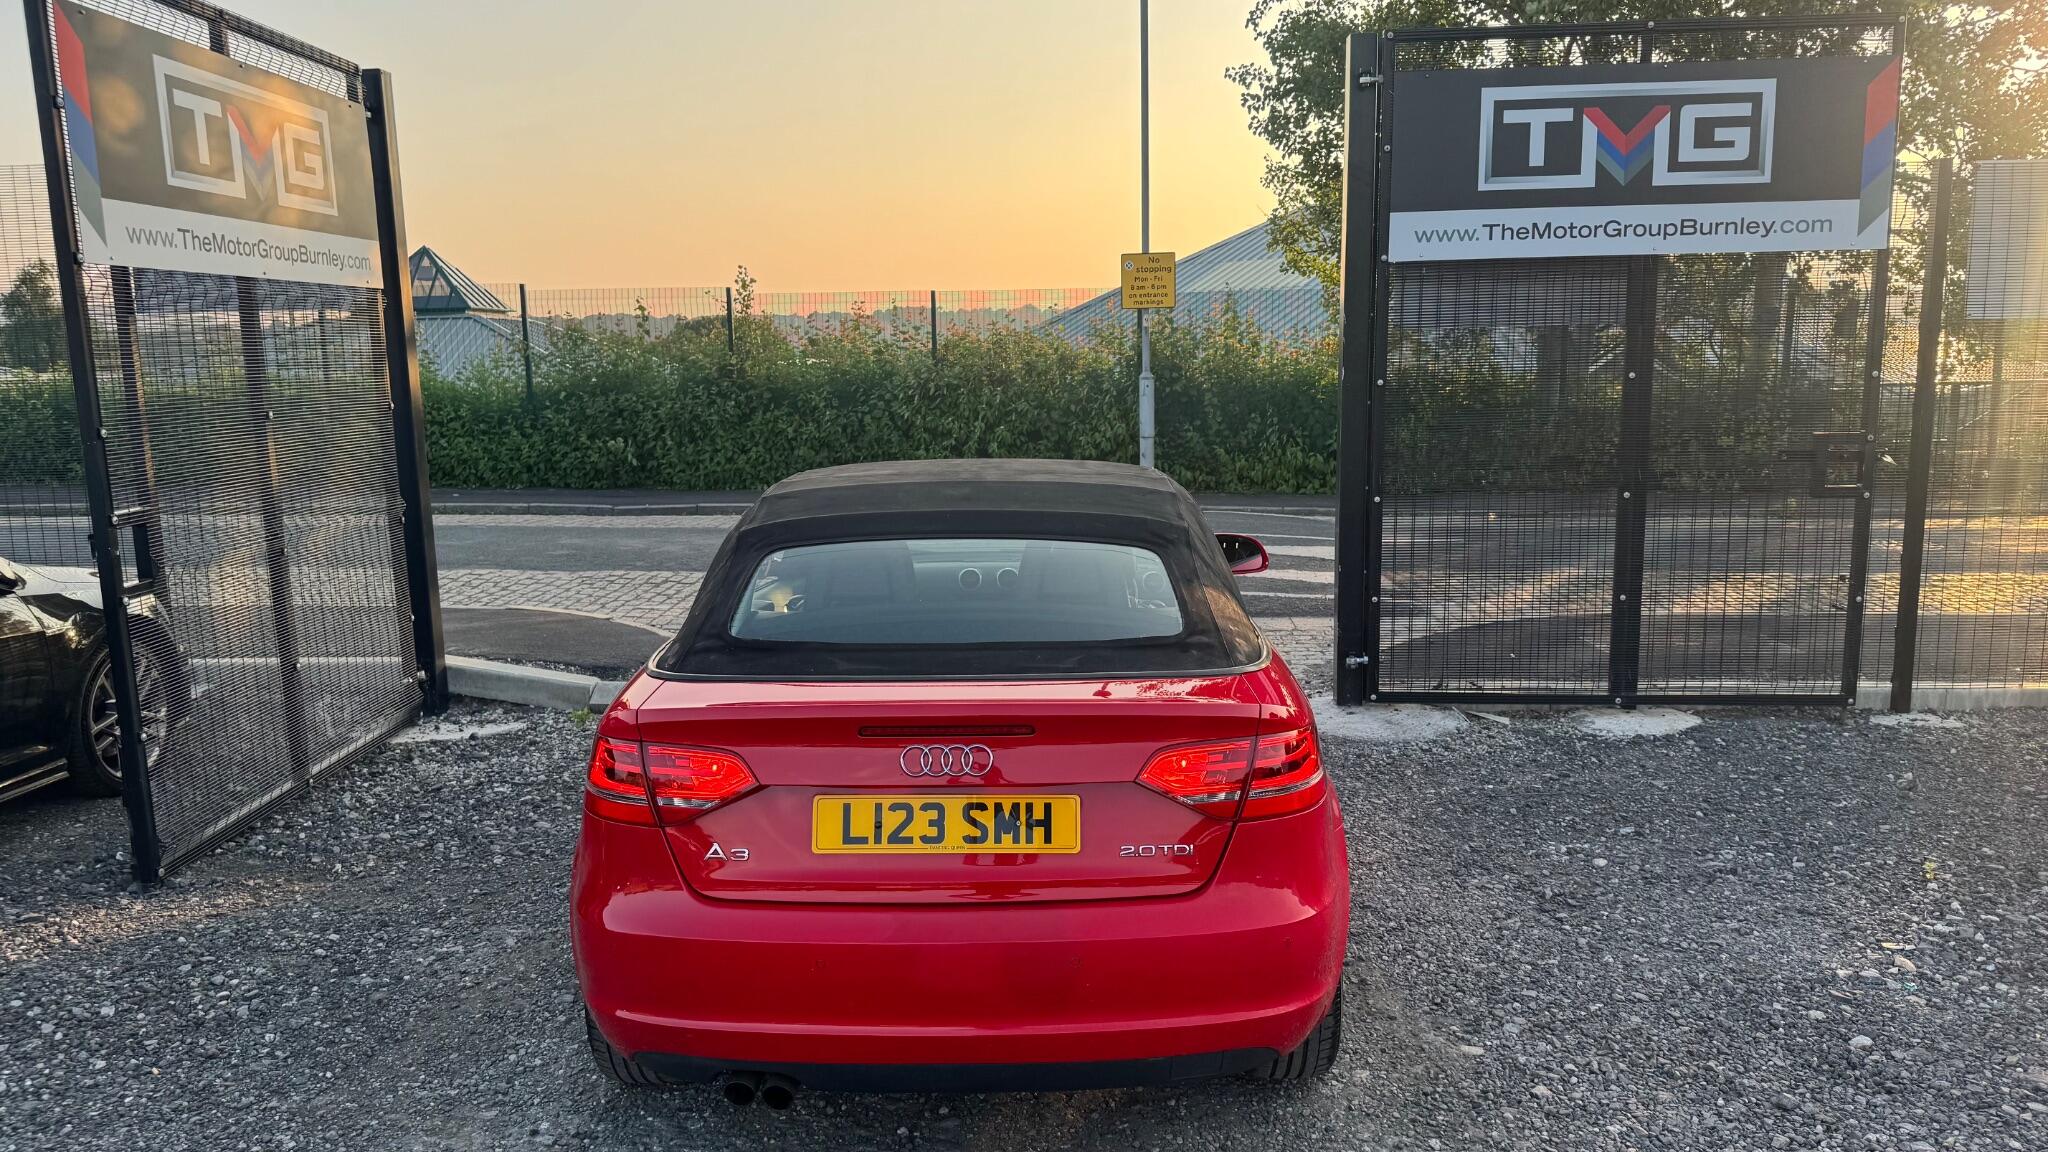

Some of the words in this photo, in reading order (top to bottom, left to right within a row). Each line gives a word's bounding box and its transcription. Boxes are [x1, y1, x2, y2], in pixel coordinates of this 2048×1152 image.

[171, 86, 326, 200] TMG
[1502, 102, 1753, 187] TMG
[125, 226, 371, 271] www.TheMotorGroupBurnley.com
[1414, 216, 1833, 244] www.TheMotorGroupBurnley.com
[1135, 265, 1172, 273] stopping
[842, 802, 946, 846] L123
[961, 802, 1053, 846] SMH
